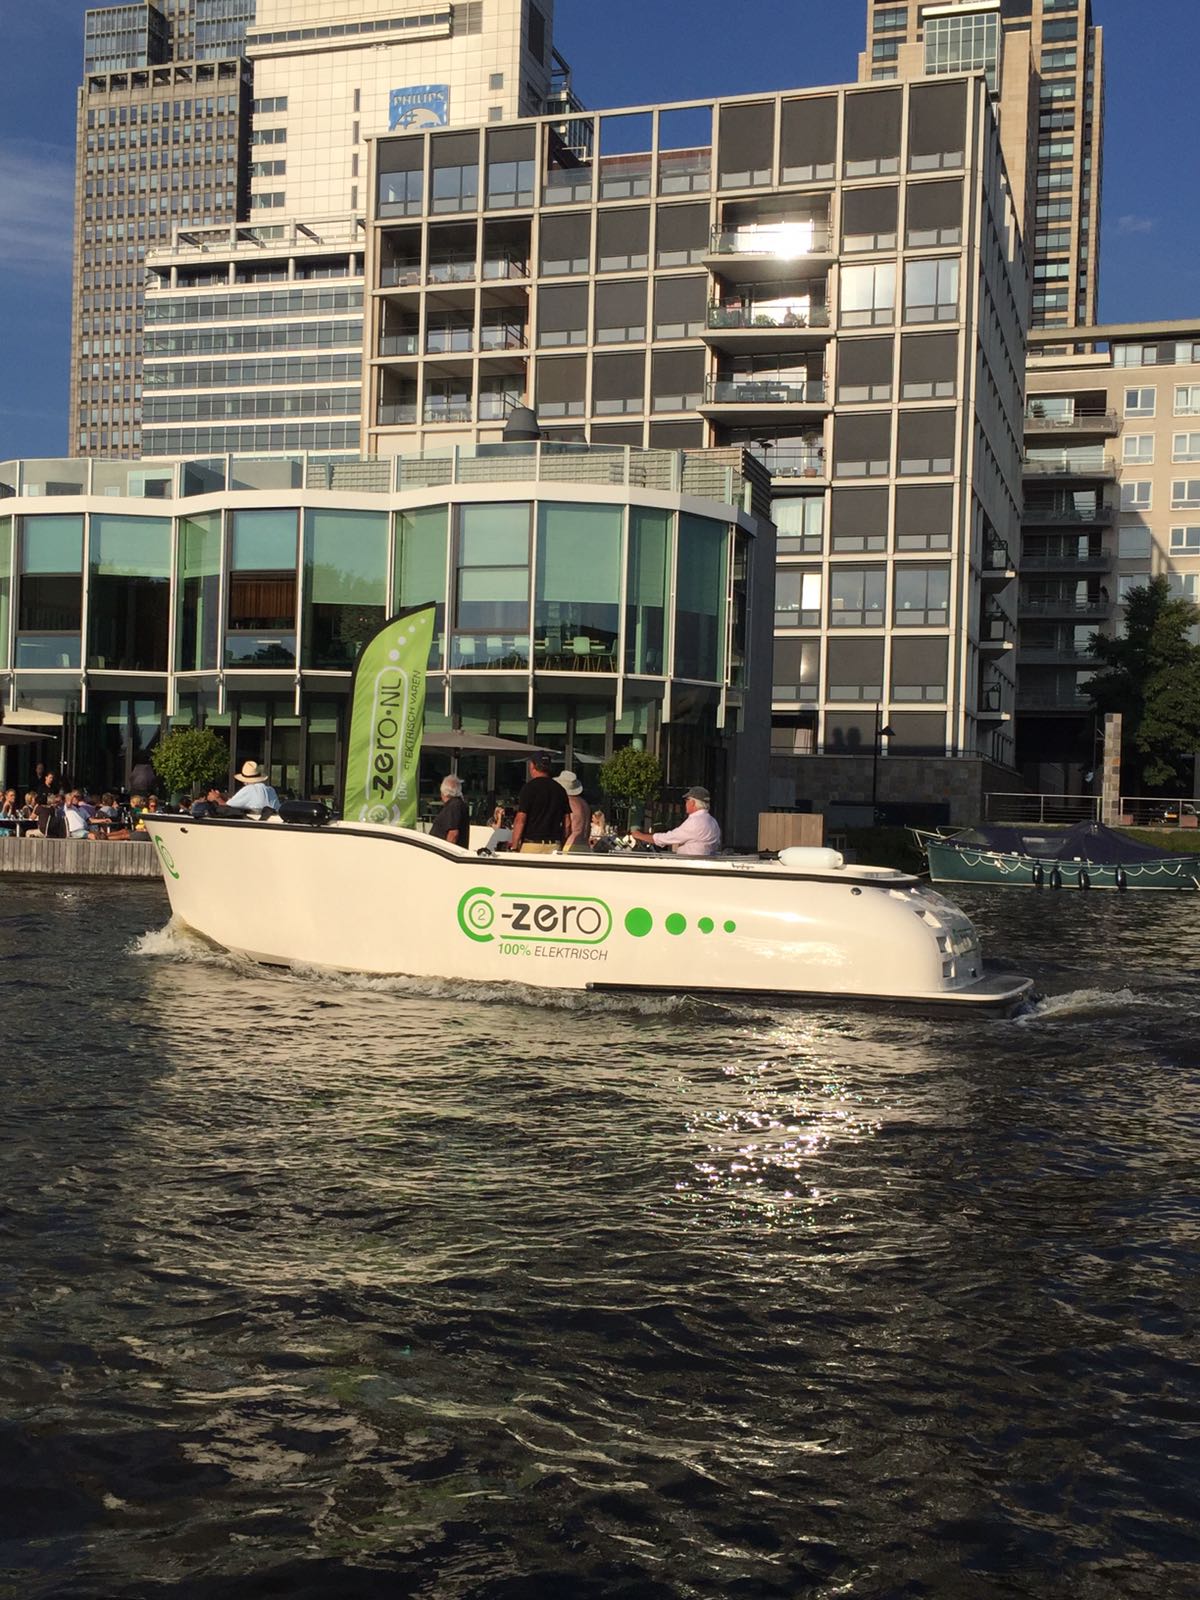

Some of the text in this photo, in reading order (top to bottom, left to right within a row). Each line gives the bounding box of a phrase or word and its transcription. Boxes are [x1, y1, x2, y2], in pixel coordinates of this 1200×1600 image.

[394, 92, 445, 106] PHILIPS
[410, 670, 421, 705] VAREN
[497, 943, 608, 961] 100% ELEKTRISCH
